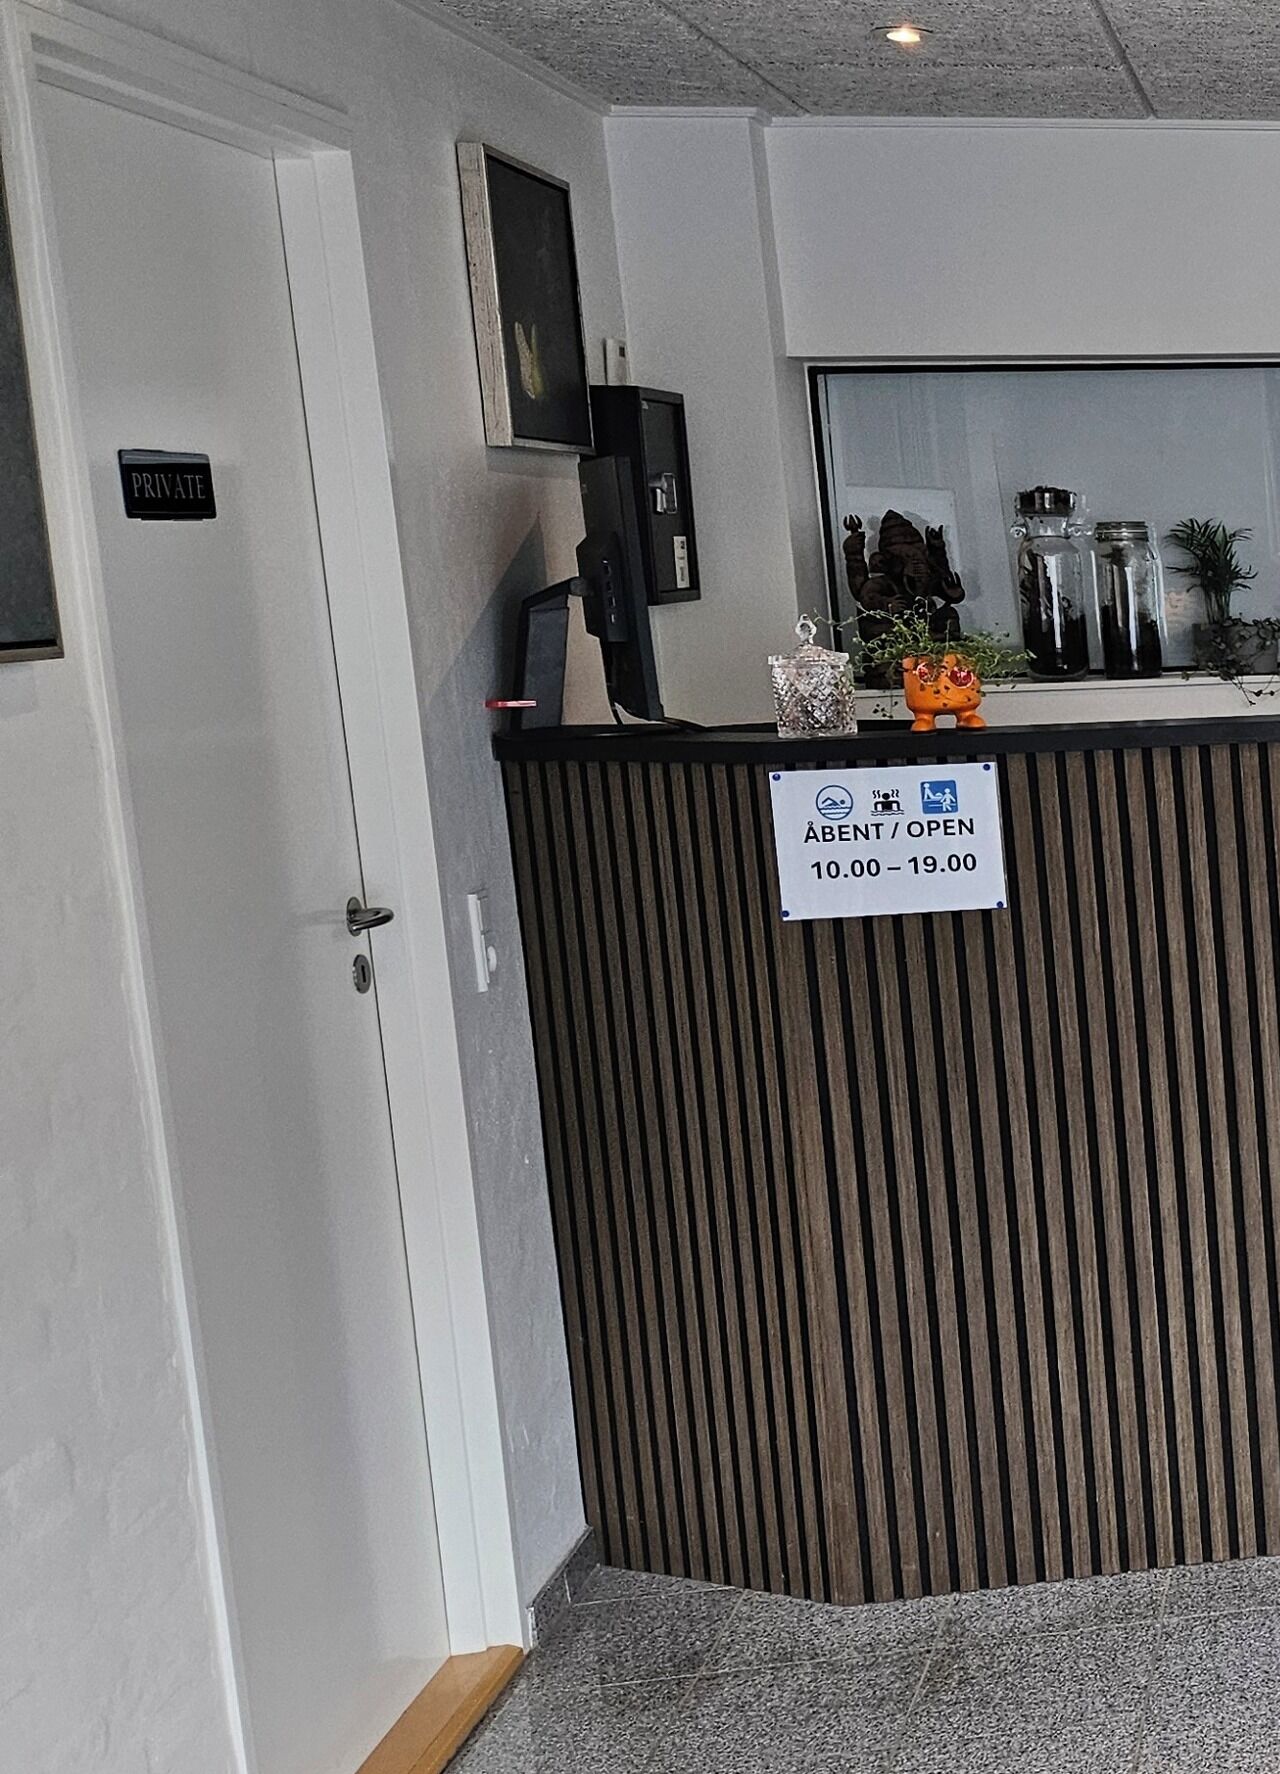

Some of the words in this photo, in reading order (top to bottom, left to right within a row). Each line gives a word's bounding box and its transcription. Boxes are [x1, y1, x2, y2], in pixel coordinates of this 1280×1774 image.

[132, 472, 206, 499] PRIVATE
[804, 820, 884, 843] ÅBENT
[891, 822, 899, 839] /
[906, 818, 975, 838] OPEN
[811, 858, 881, 880] 10.00
[908, 853, 977, 874] 19.00
